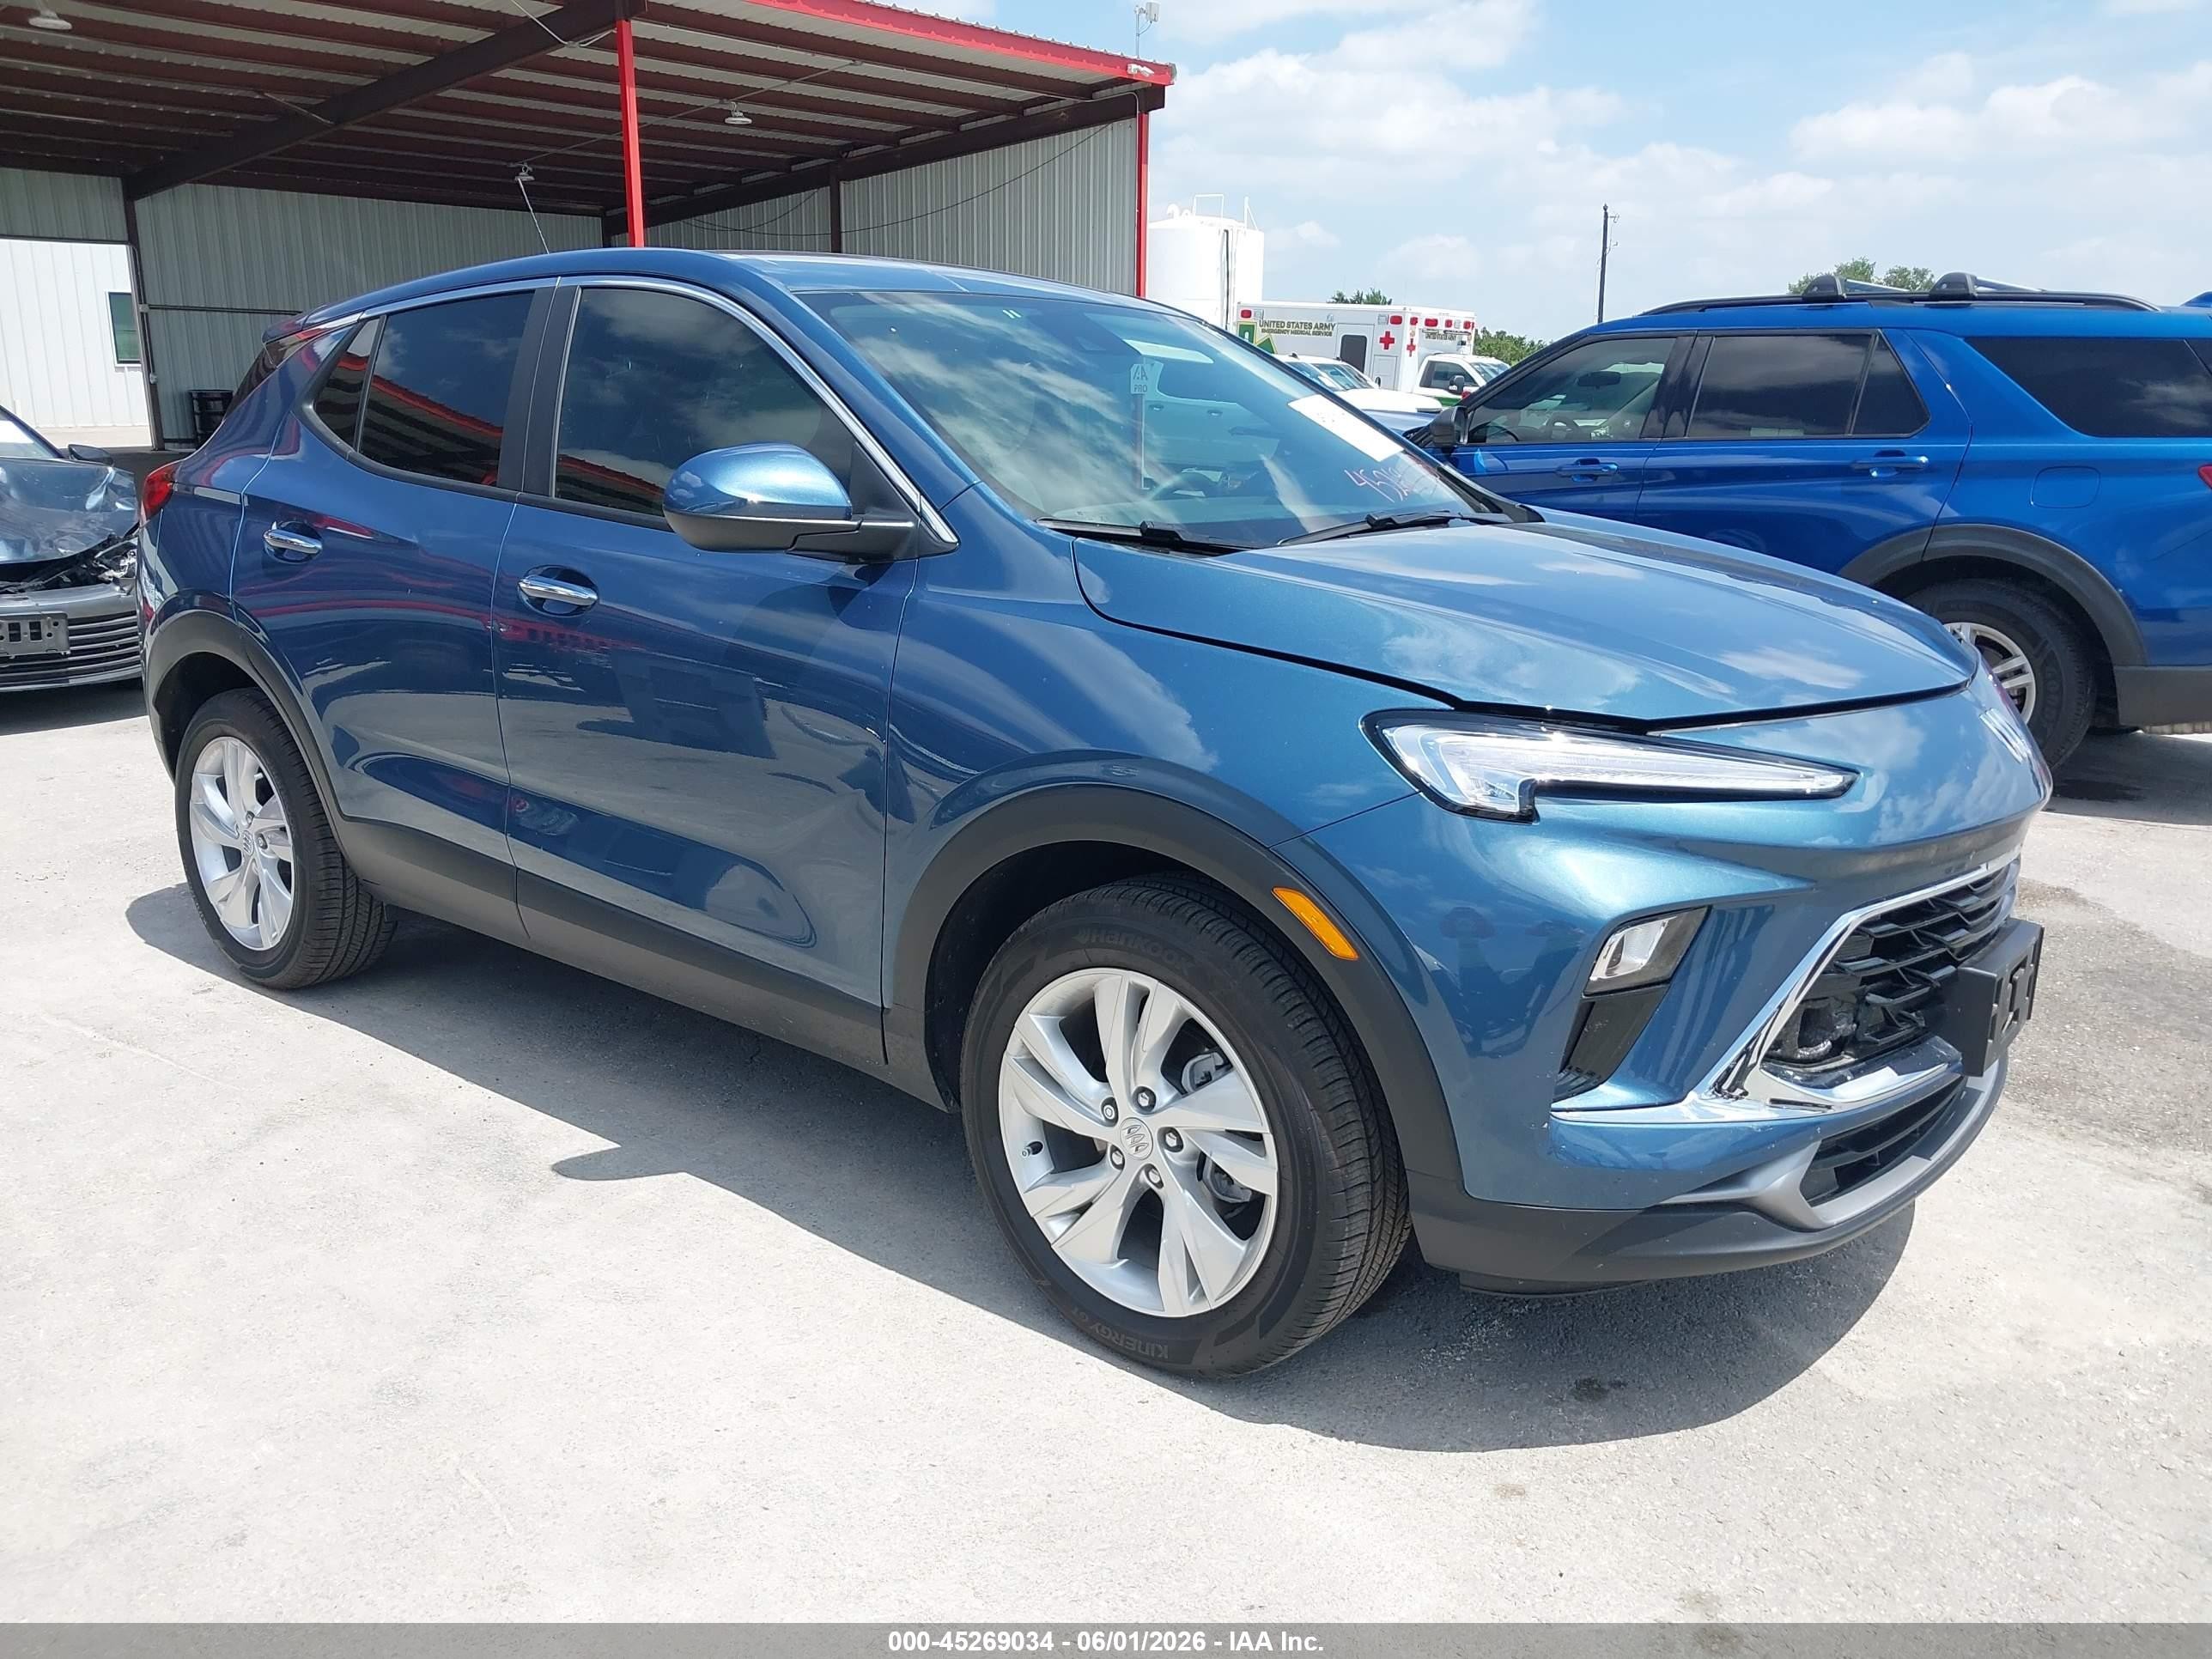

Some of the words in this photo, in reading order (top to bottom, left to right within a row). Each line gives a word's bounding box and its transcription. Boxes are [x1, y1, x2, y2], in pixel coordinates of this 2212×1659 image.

[1259, 319, 1285, 329] UNITED
[1287, 321, 1314, 330] STATES
[1314, 322, 1336, 331] ARMY
[1089, 1322, 1170, 1359] KINERGY
